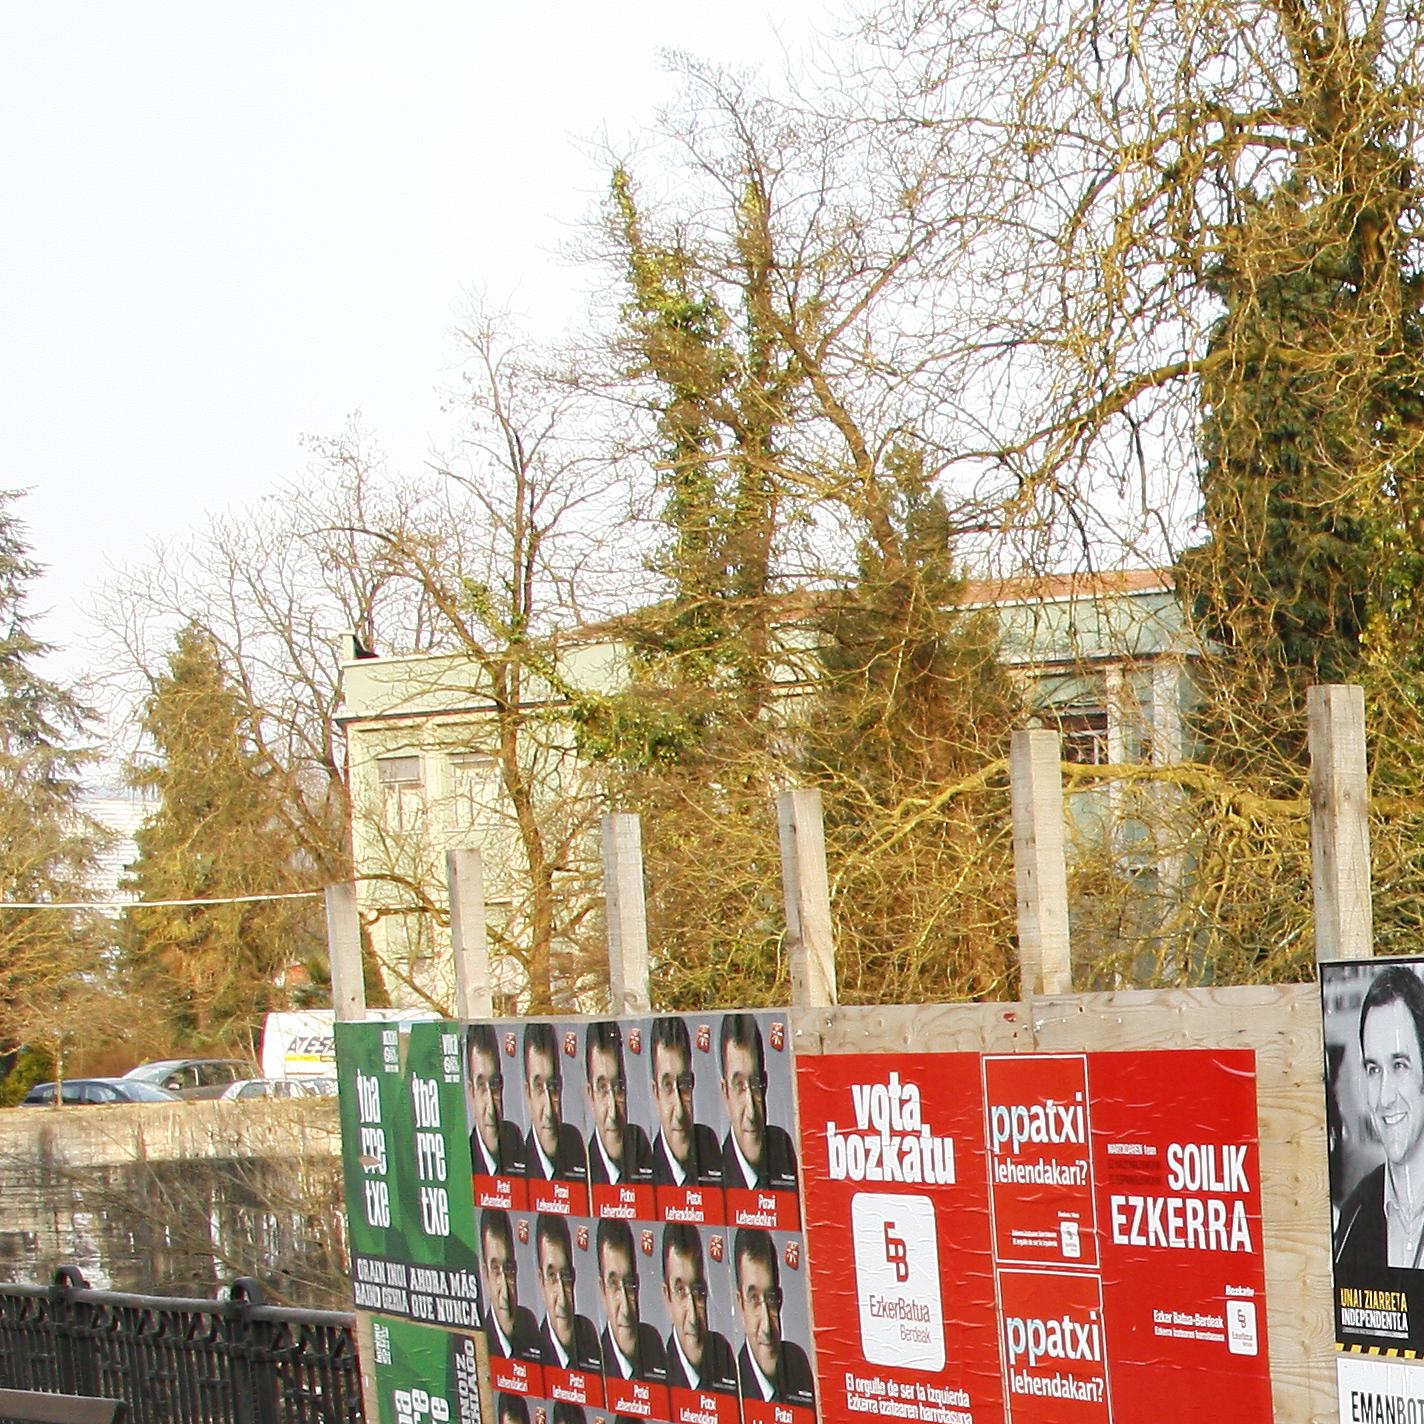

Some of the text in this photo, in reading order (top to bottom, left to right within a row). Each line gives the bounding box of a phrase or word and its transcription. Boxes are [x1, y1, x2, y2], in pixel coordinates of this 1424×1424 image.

[851, 1072, 921, 1131] vota
[991, 1092, 1085, 1154] ppatxi
[416, 1132, 447, 1181] rre
[826, 1122, 956, 1185] bozkatu
[994, 1157, 1088, 1186] lehendakari?
[1167, 1143, 1250, 1193] SOILIK
[420, 1186, 449, 1237] txe
[1110, 1195, 1253, 1253] EZKERRA
[410, 1267, 448, 1296] AHORA
[450, 1269, 478, 1299] MÁS
[1340, 1287, 1408, 1312] UNAI ZIARRETA
[411, 1294, 436, 1321] QUE
[436, 1298, 481, 1327] NUNCA
[1341, 1307, 1408, 1331] INDEPENDENTEA
[1006, 1311, 1101, 1366] ppatxi
[887, 1379, 899, 1397] de
[900, 1383, 915, 1399] ser
[916, 1383, 926, 1401] la
[927, 1384, 970, 1408] izquierda
[1011, 1371, 1103, 1402] lehendakari?
